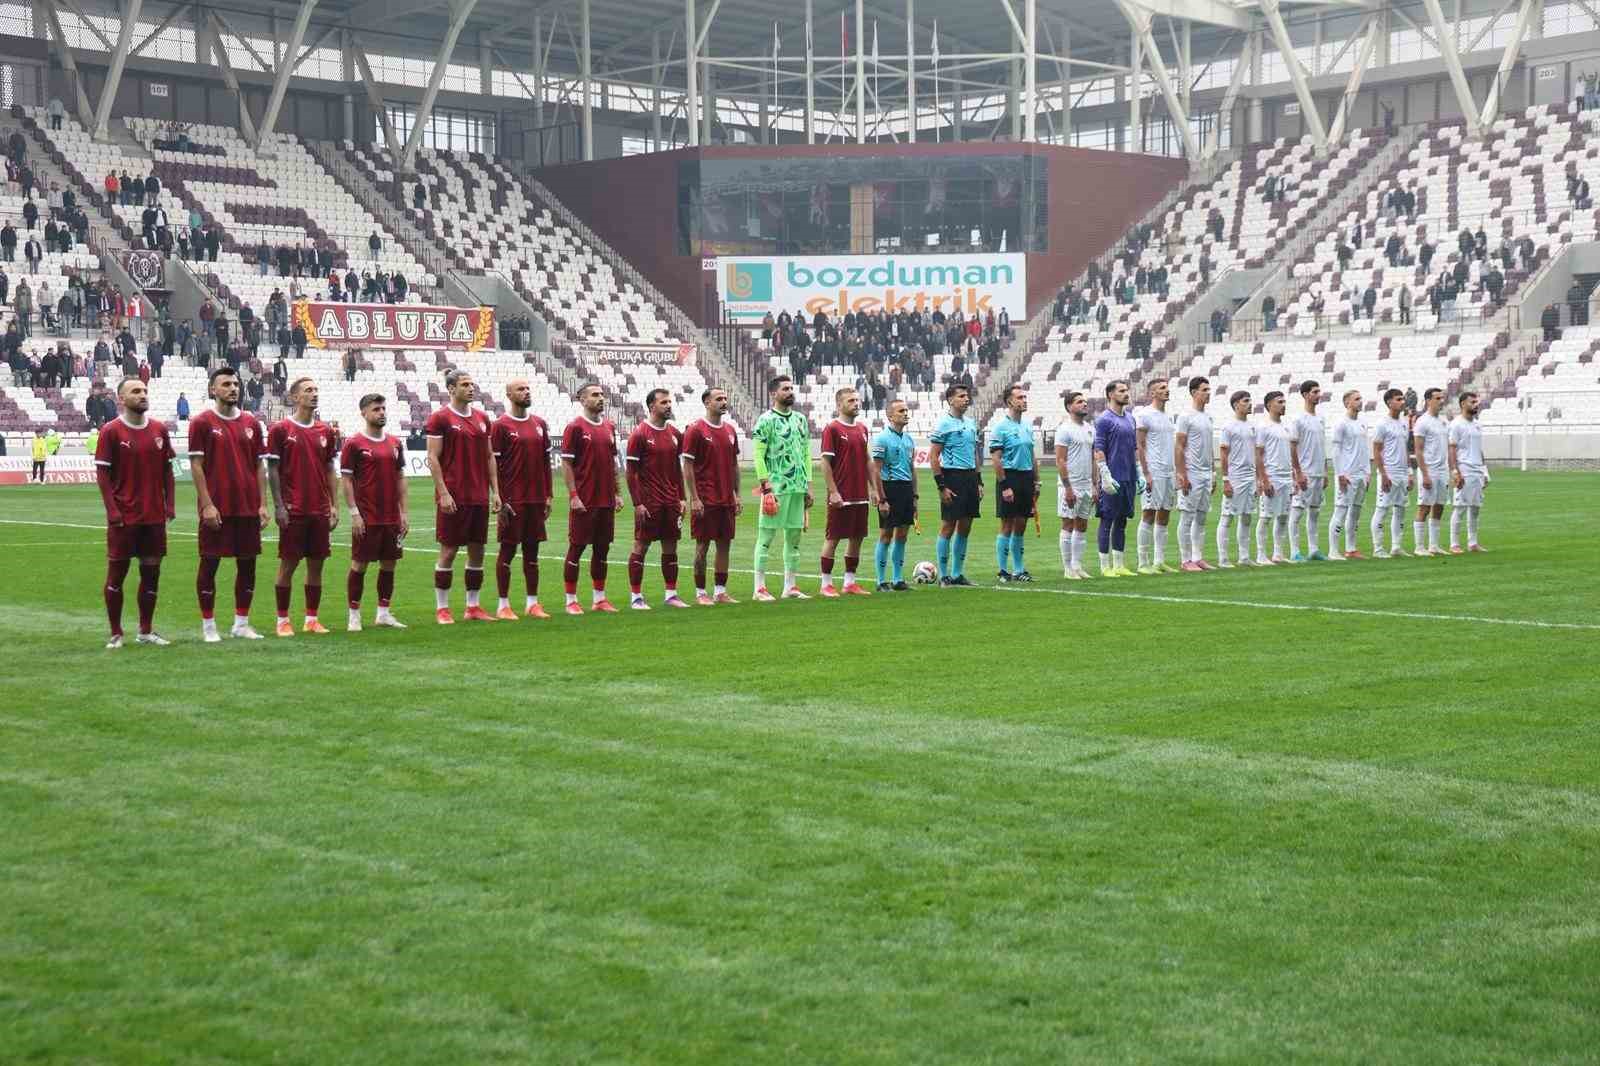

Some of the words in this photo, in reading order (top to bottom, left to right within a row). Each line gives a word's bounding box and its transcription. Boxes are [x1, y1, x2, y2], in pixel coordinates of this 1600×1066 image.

[787, 260, 1013, 287] bozduman
[805, 287, 992, 316] elektrik
[317, 308, 474, 342] ABLUKA
[599, 350, 642, 363] ABLUKA
[643, 351, 678, 363] GRUBU
